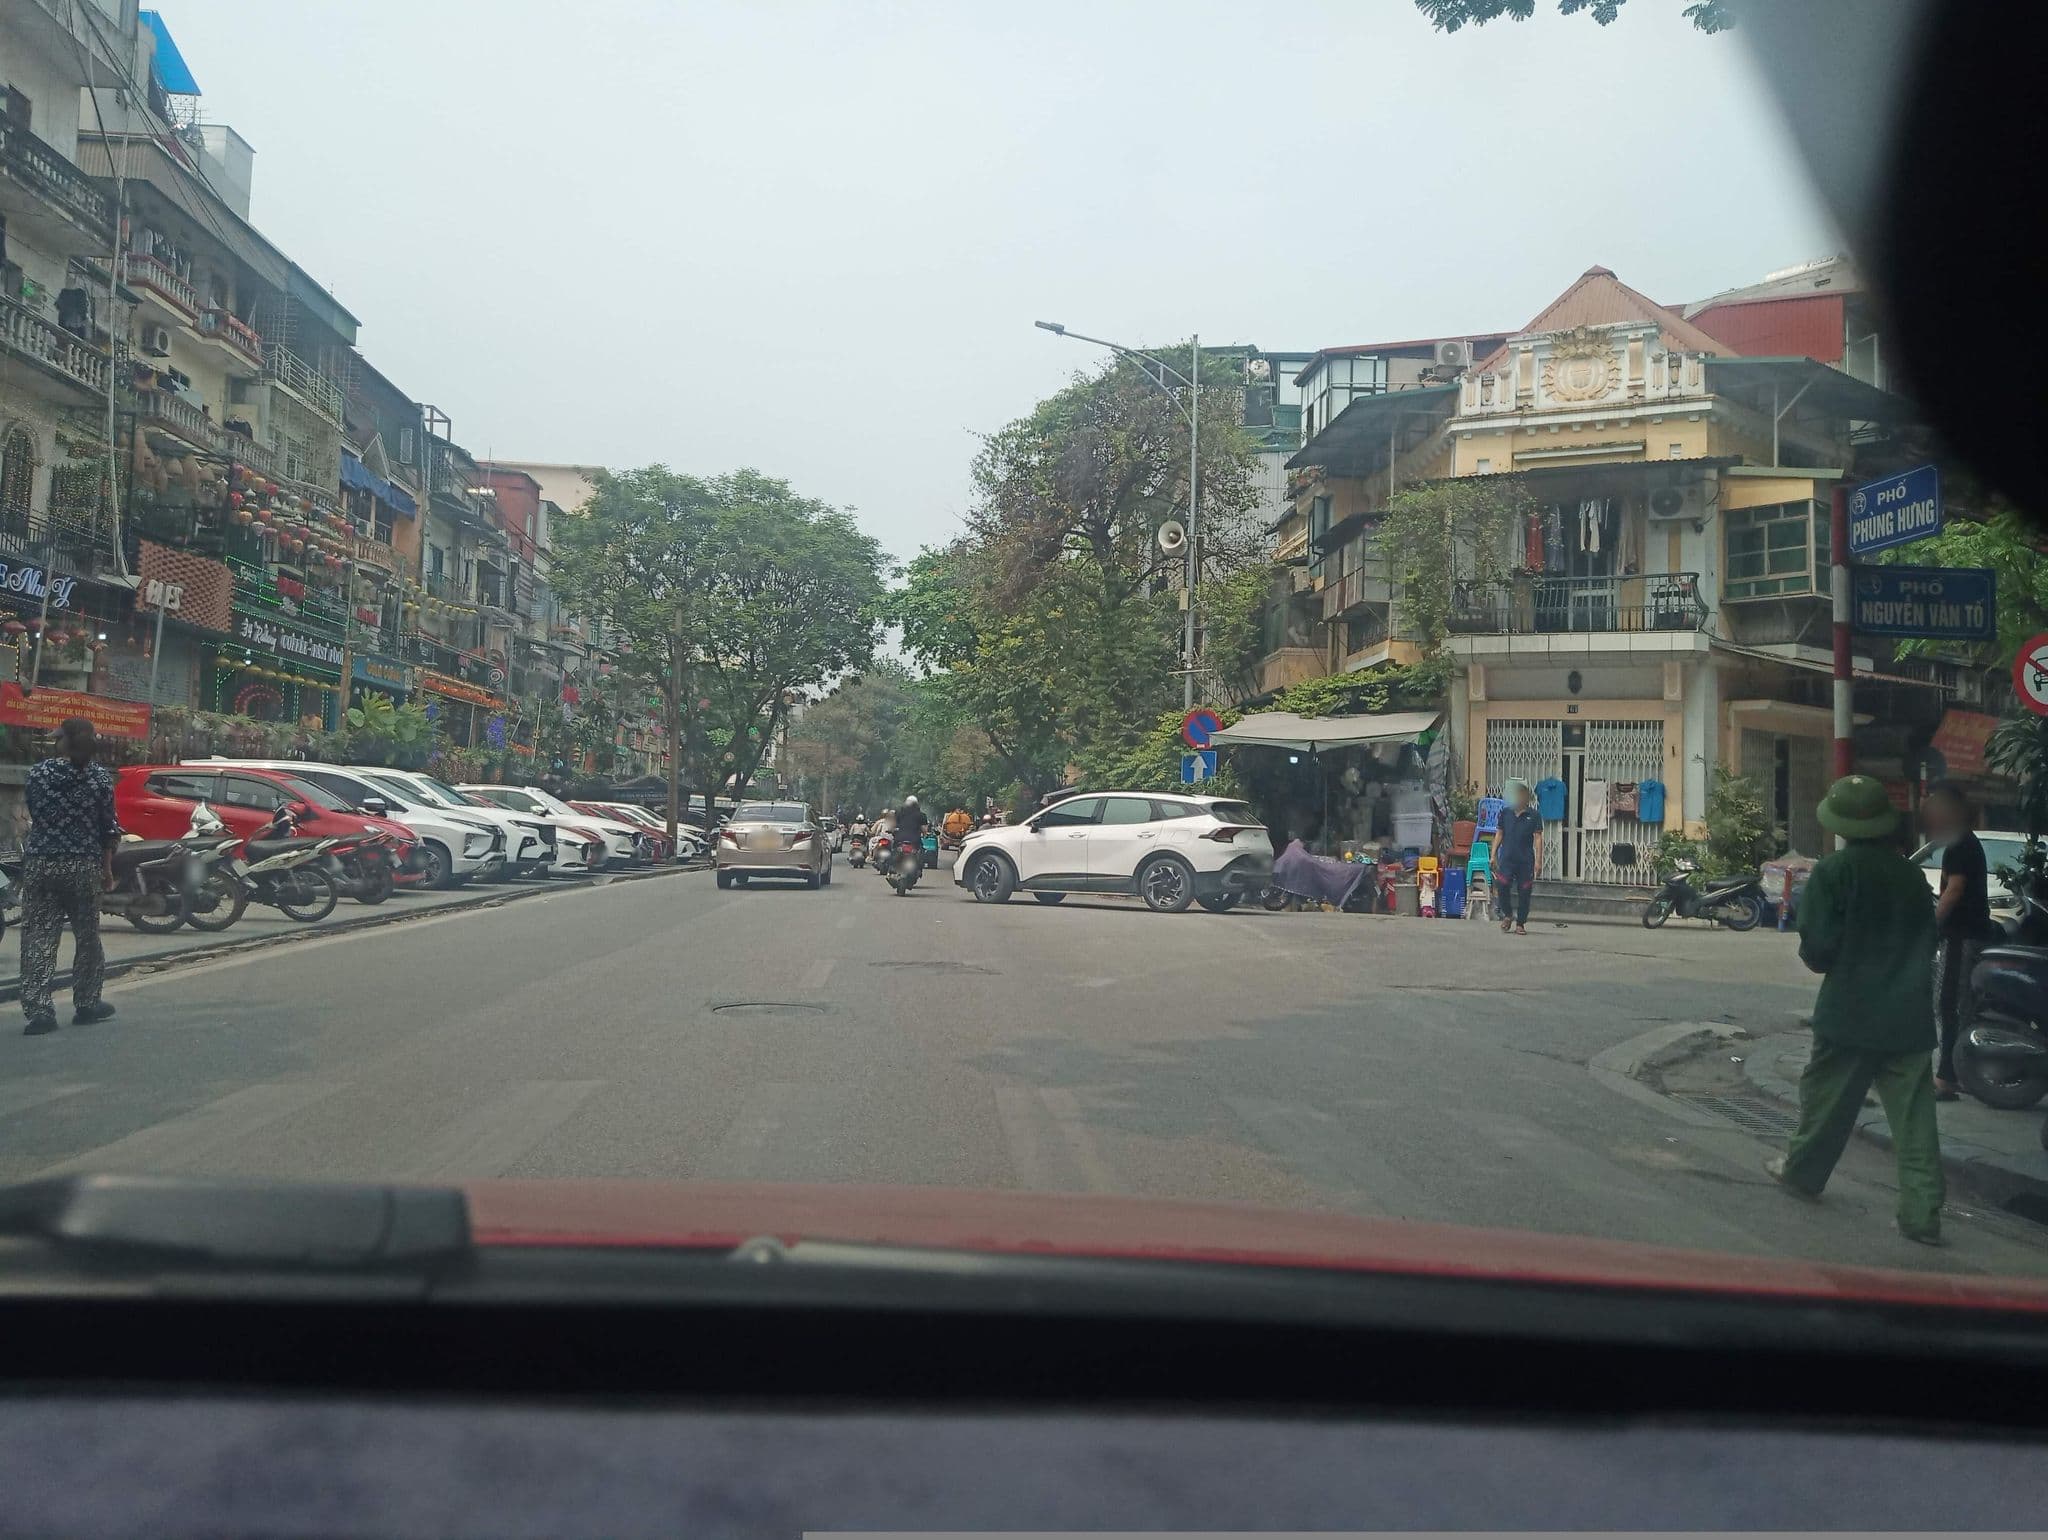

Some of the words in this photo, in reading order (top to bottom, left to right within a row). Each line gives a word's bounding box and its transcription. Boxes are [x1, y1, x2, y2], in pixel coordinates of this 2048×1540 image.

[1877, 479, 1906, 506] PHỐ
[1853, 511, 1894, 545] PHÙNG
[1898, 499, 1935, 532] HƯNG
[1900, 577, 1944, 595] PHỐ
